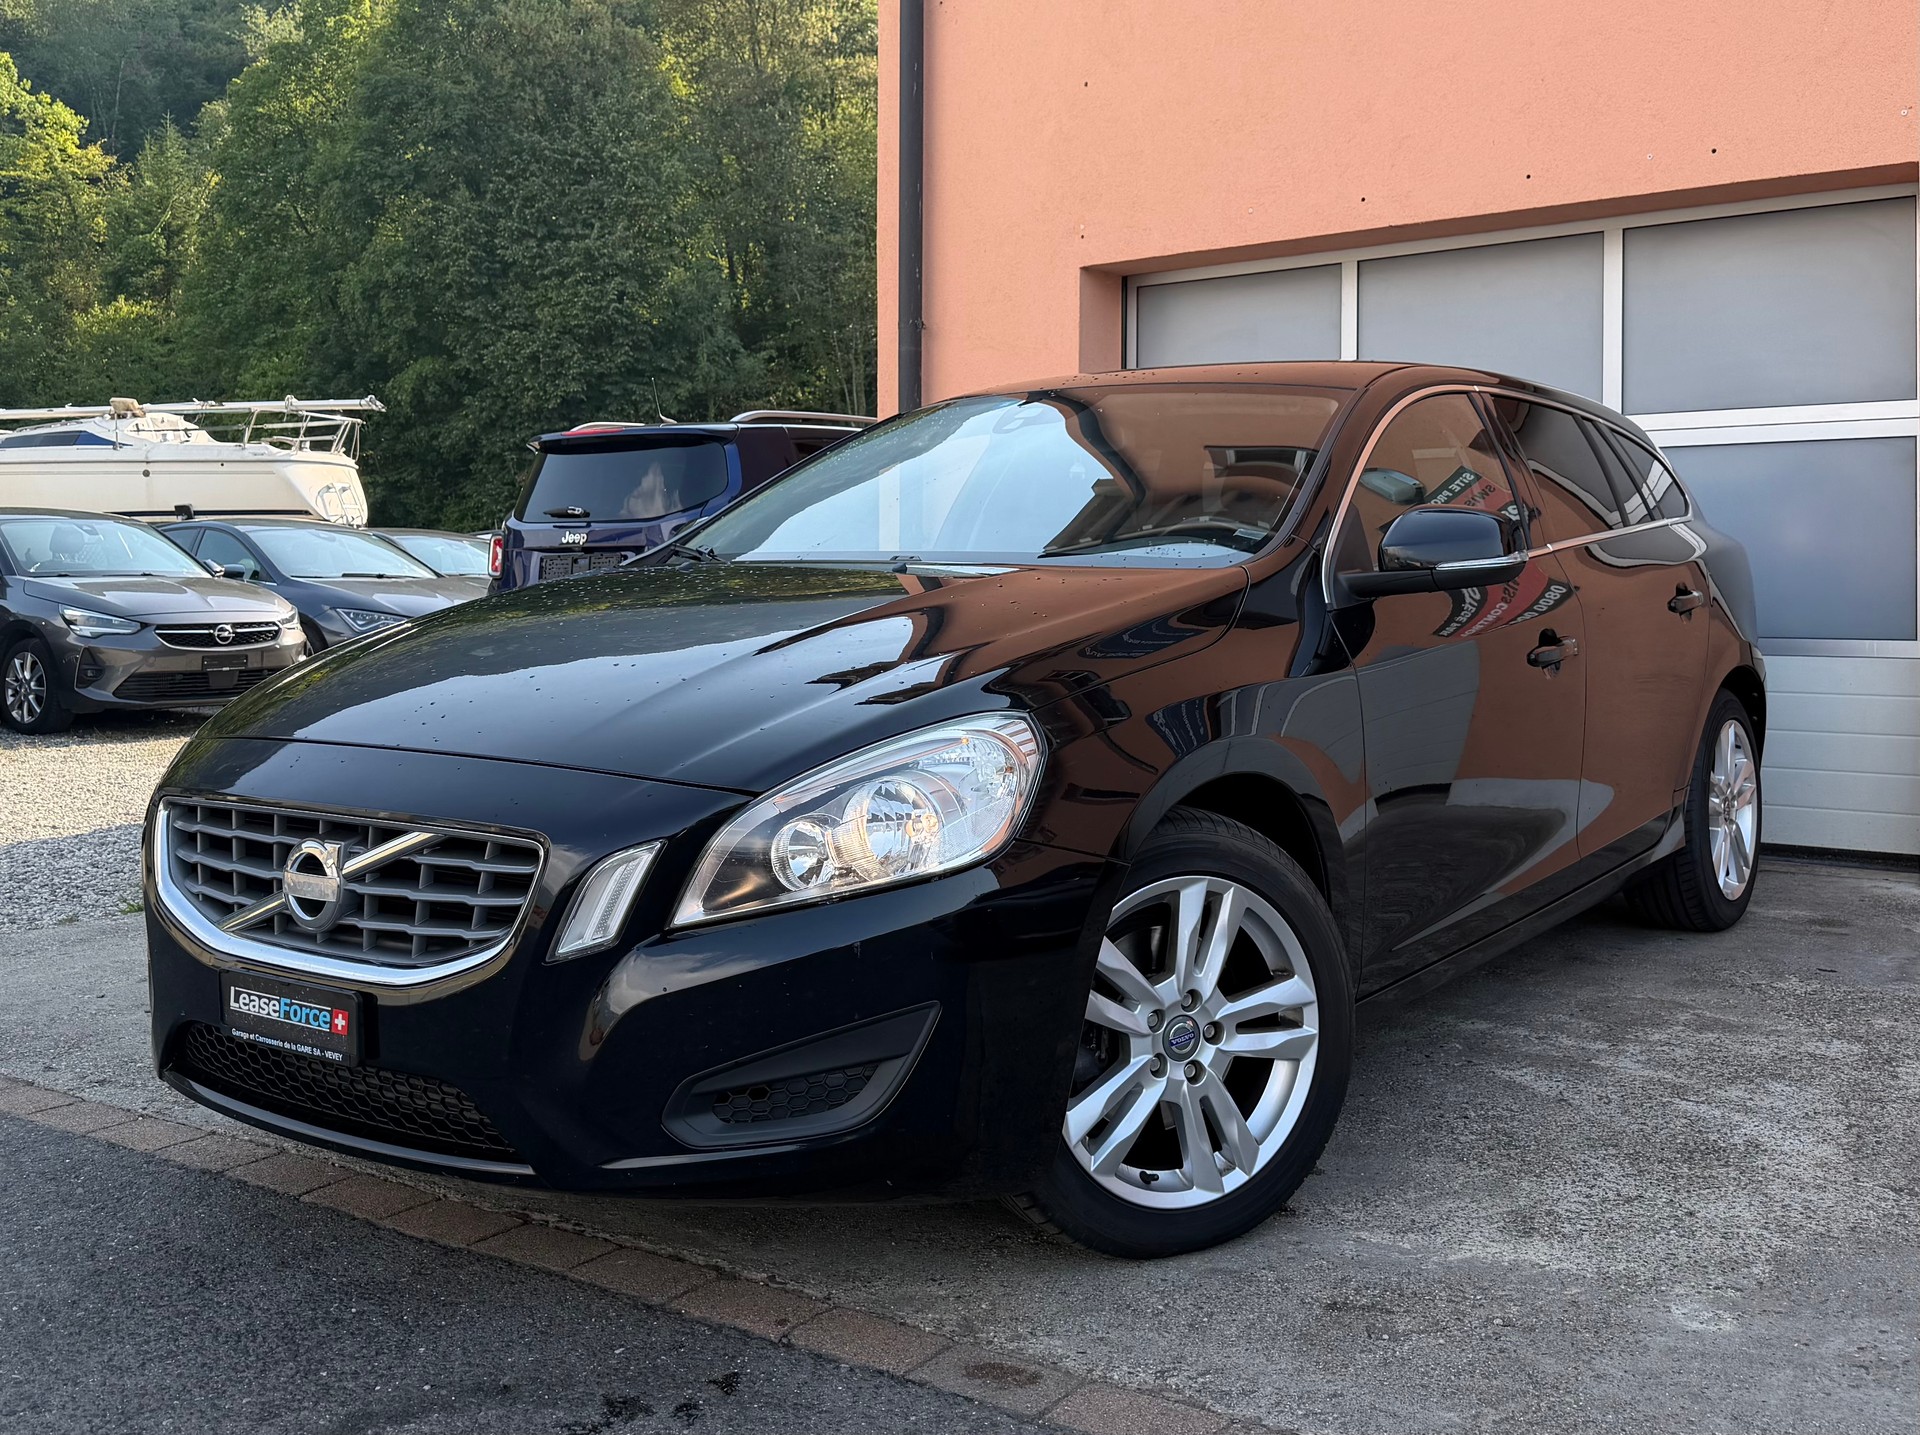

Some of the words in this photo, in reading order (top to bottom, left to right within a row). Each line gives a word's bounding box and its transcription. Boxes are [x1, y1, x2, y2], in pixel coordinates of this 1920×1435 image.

[561, 531, 587, 545] Jeep
[230, 986, 331, 1029] LeaseForce
[231, 1028, 249, 1040] Garage
[297, 1044, 312, 1055] GARE
[312, 1048, 322, 1056] SA
[325, 1050, 343, 1061] VEVEY
[1170, 1032, 1195, 1045] VOLVO
